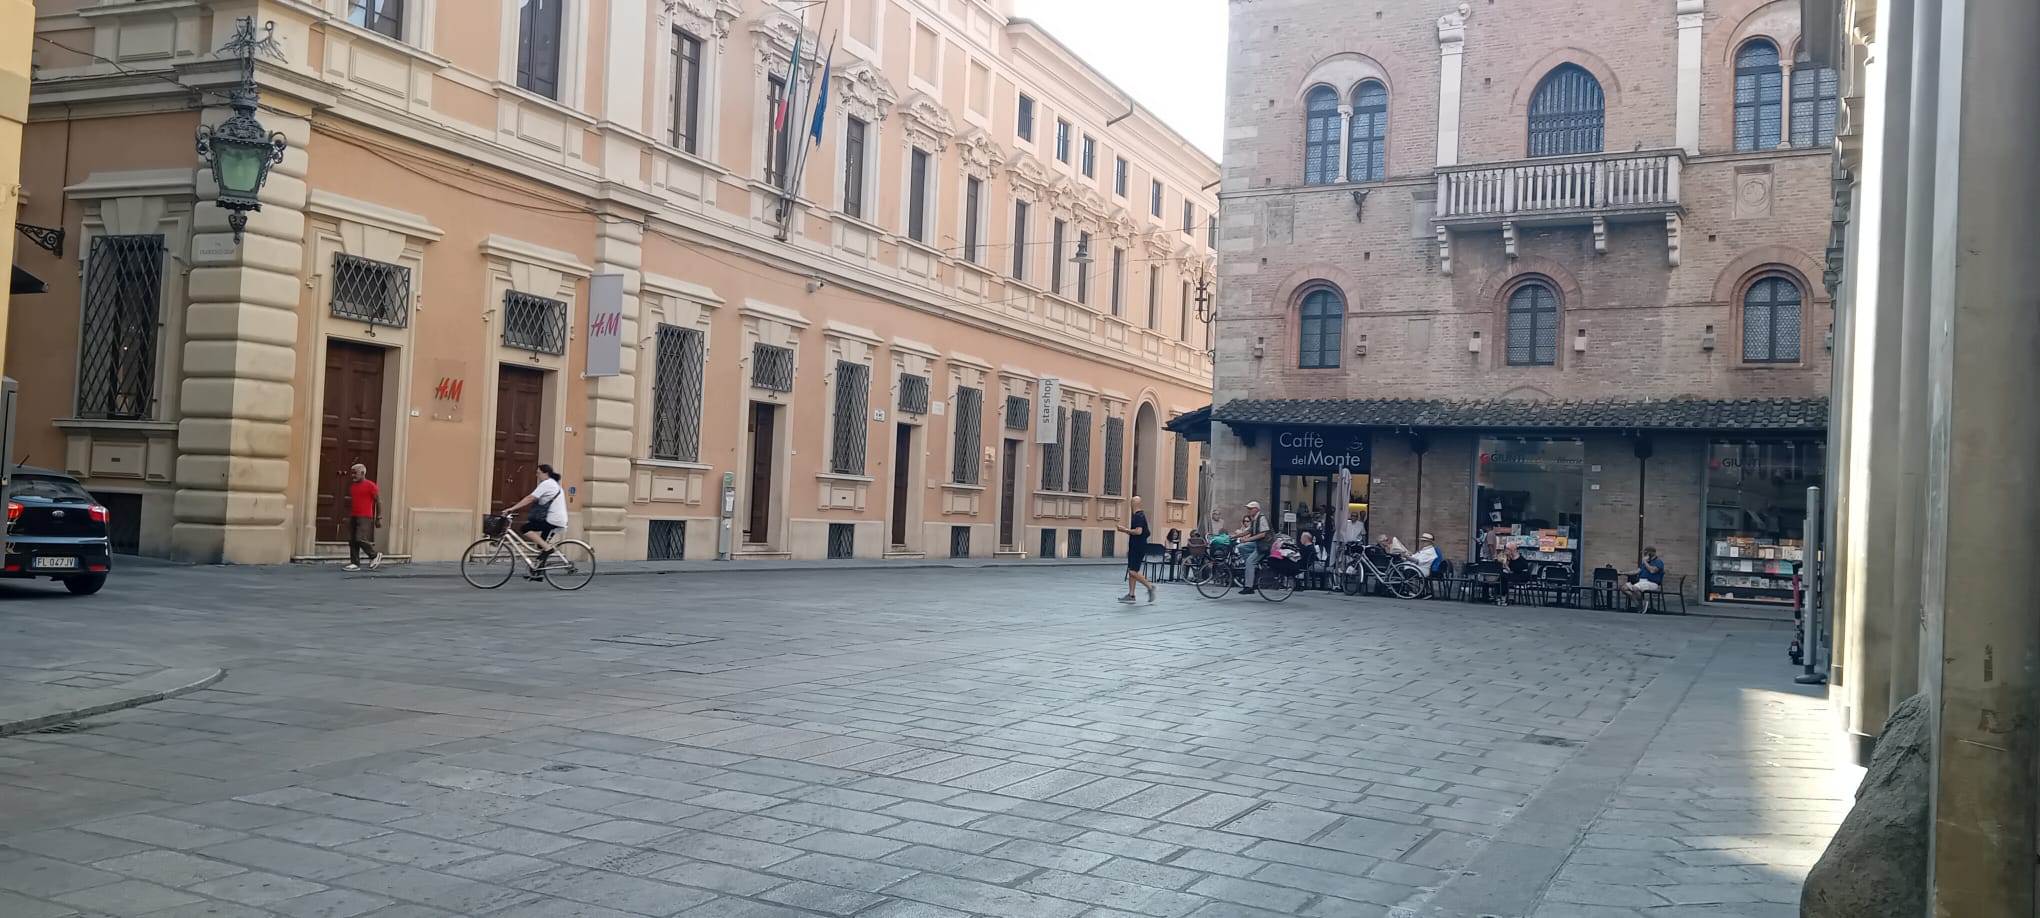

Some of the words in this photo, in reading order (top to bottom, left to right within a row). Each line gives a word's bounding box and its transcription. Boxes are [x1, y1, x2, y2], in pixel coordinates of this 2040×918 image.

[590, 311, 621, 337] H&M
[434, 376, 464, 403] H&M
[1042, 380, 1053, 423] starshop
[1279, 431, 1324, 448] Caffè
[1291, 455, 1306, 465] del
[1307, 450, 1361, 466] Monte
[38, 558, 47, 566] FL
